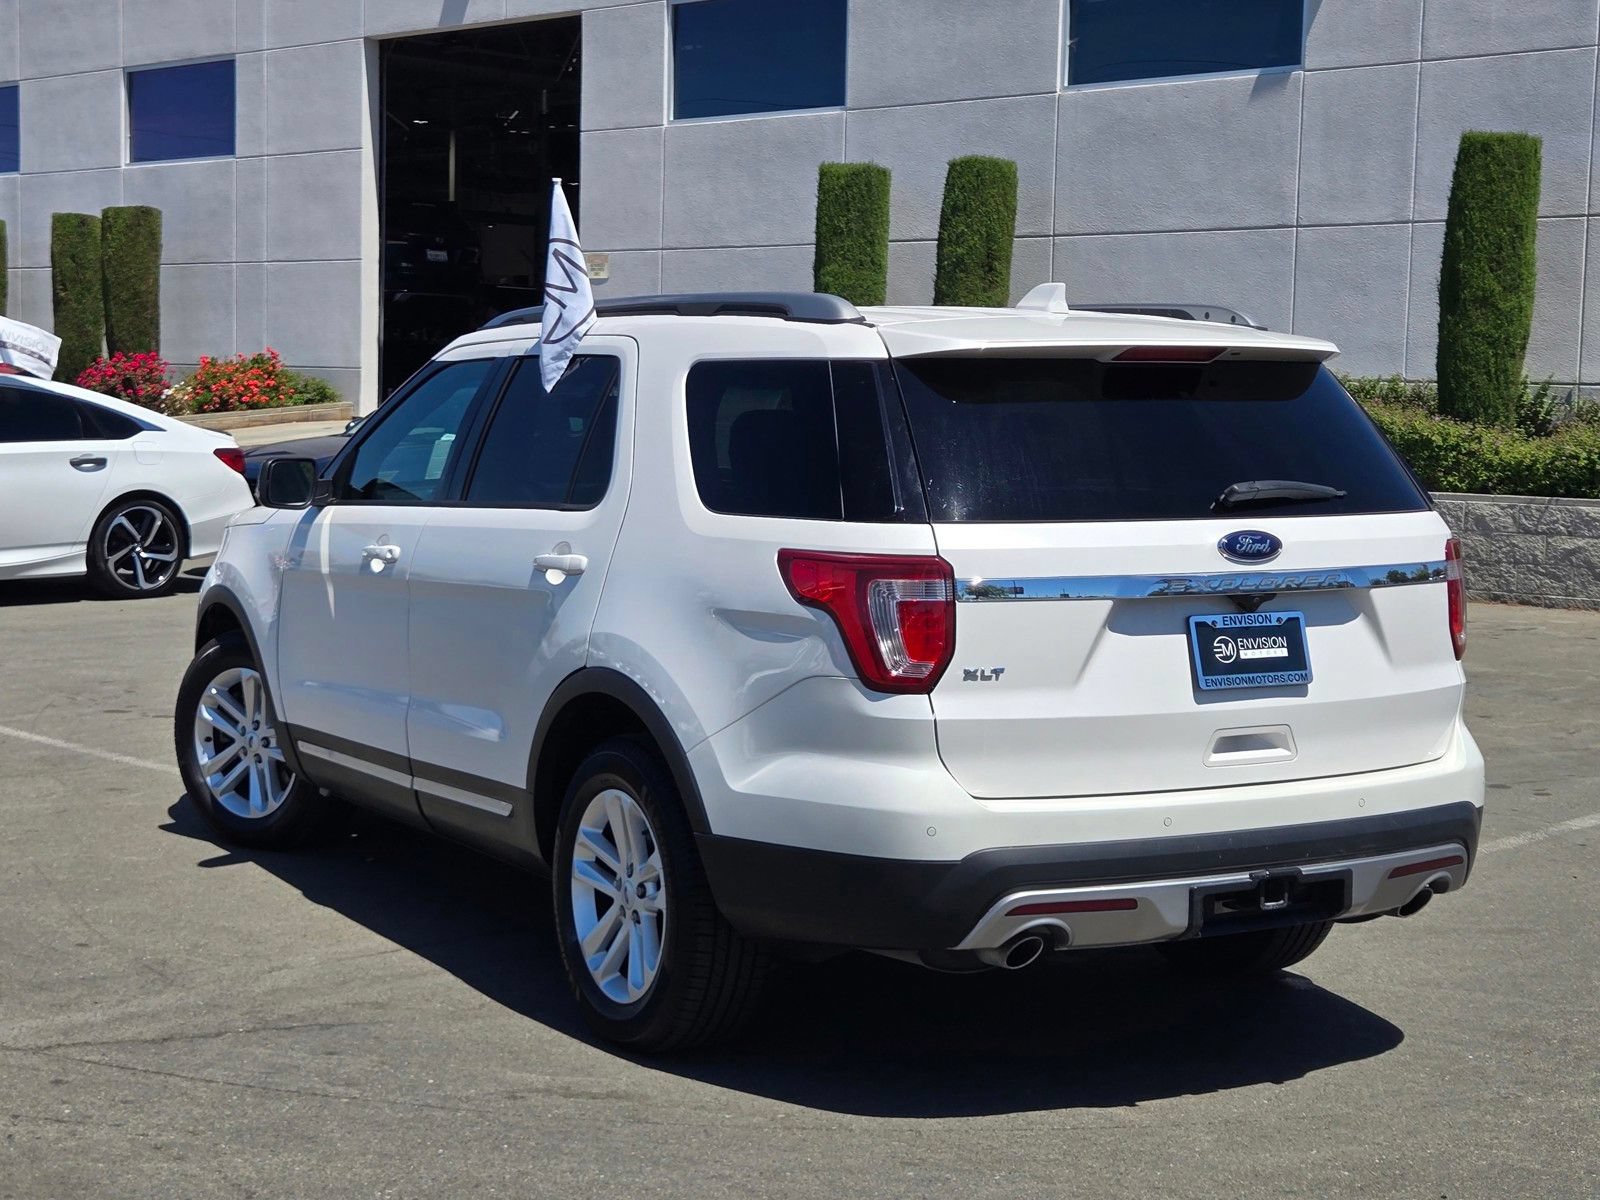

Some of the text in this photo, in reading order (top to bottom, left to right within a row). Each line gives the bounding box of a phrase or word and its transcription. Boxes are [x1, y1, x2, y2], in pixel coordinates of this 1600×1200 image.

[1235, 534, 1270, 553] Ford
[1166, 574, 1342, 593] EXPLORER
[1222, 614, 1272, 626] ENVISION
[1237, 636, 1288, 650] ENVISION
[962, 667, 1005, 681] XLT
[1205, 673, 1308, 688] ENVISIONMOTORS.COM
